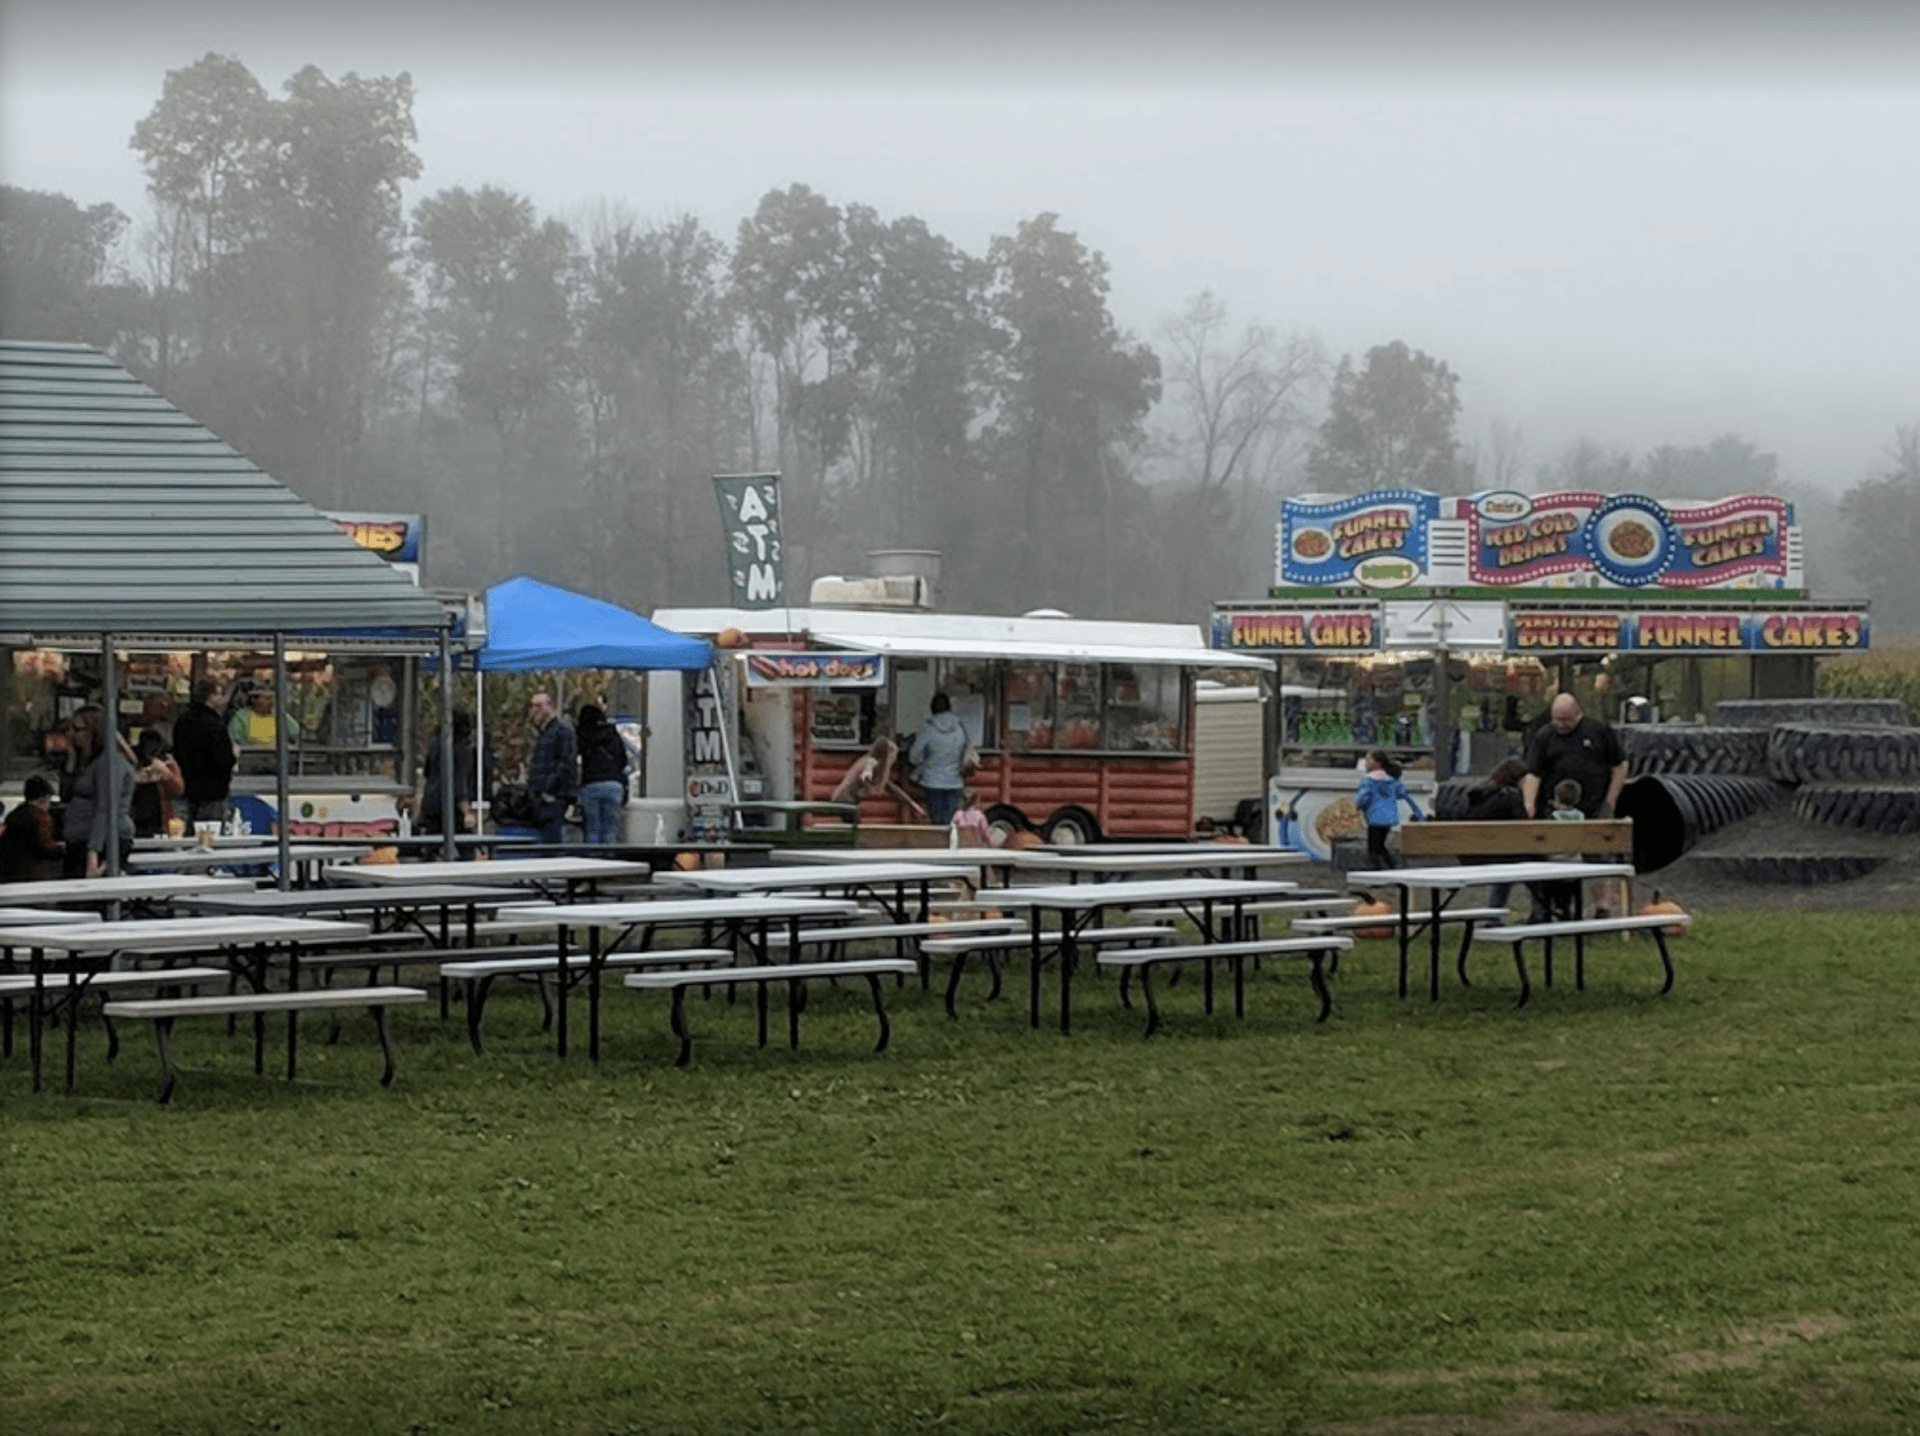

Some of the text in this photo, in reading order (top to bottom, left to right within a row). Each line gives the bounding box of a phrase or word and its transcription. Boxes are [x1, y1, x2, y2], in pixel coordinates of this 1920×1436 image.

[1333, 509, 1409, 540] FUNNEL
[1485, 512, 1578, 546] ICED COLD
[1683, 516, 1769, 546] FUNNEL
[739, 485, 776, 601] ATM
[1339, 529, 1404, 558] CAKES
[1499, 534, 1567, 567] DRINKS
[1691, 536, 1764, 567] CAKES
[1232, 614, 1373, 647] FUNNEL CAKES
[1517, 629, 1618, 647] DUTCH
[1638, 614, 1861, 647] FUNNEL CAKES
[779, 658, 876, 681] hot dogs
[694, 670, 722, 763] ATM
